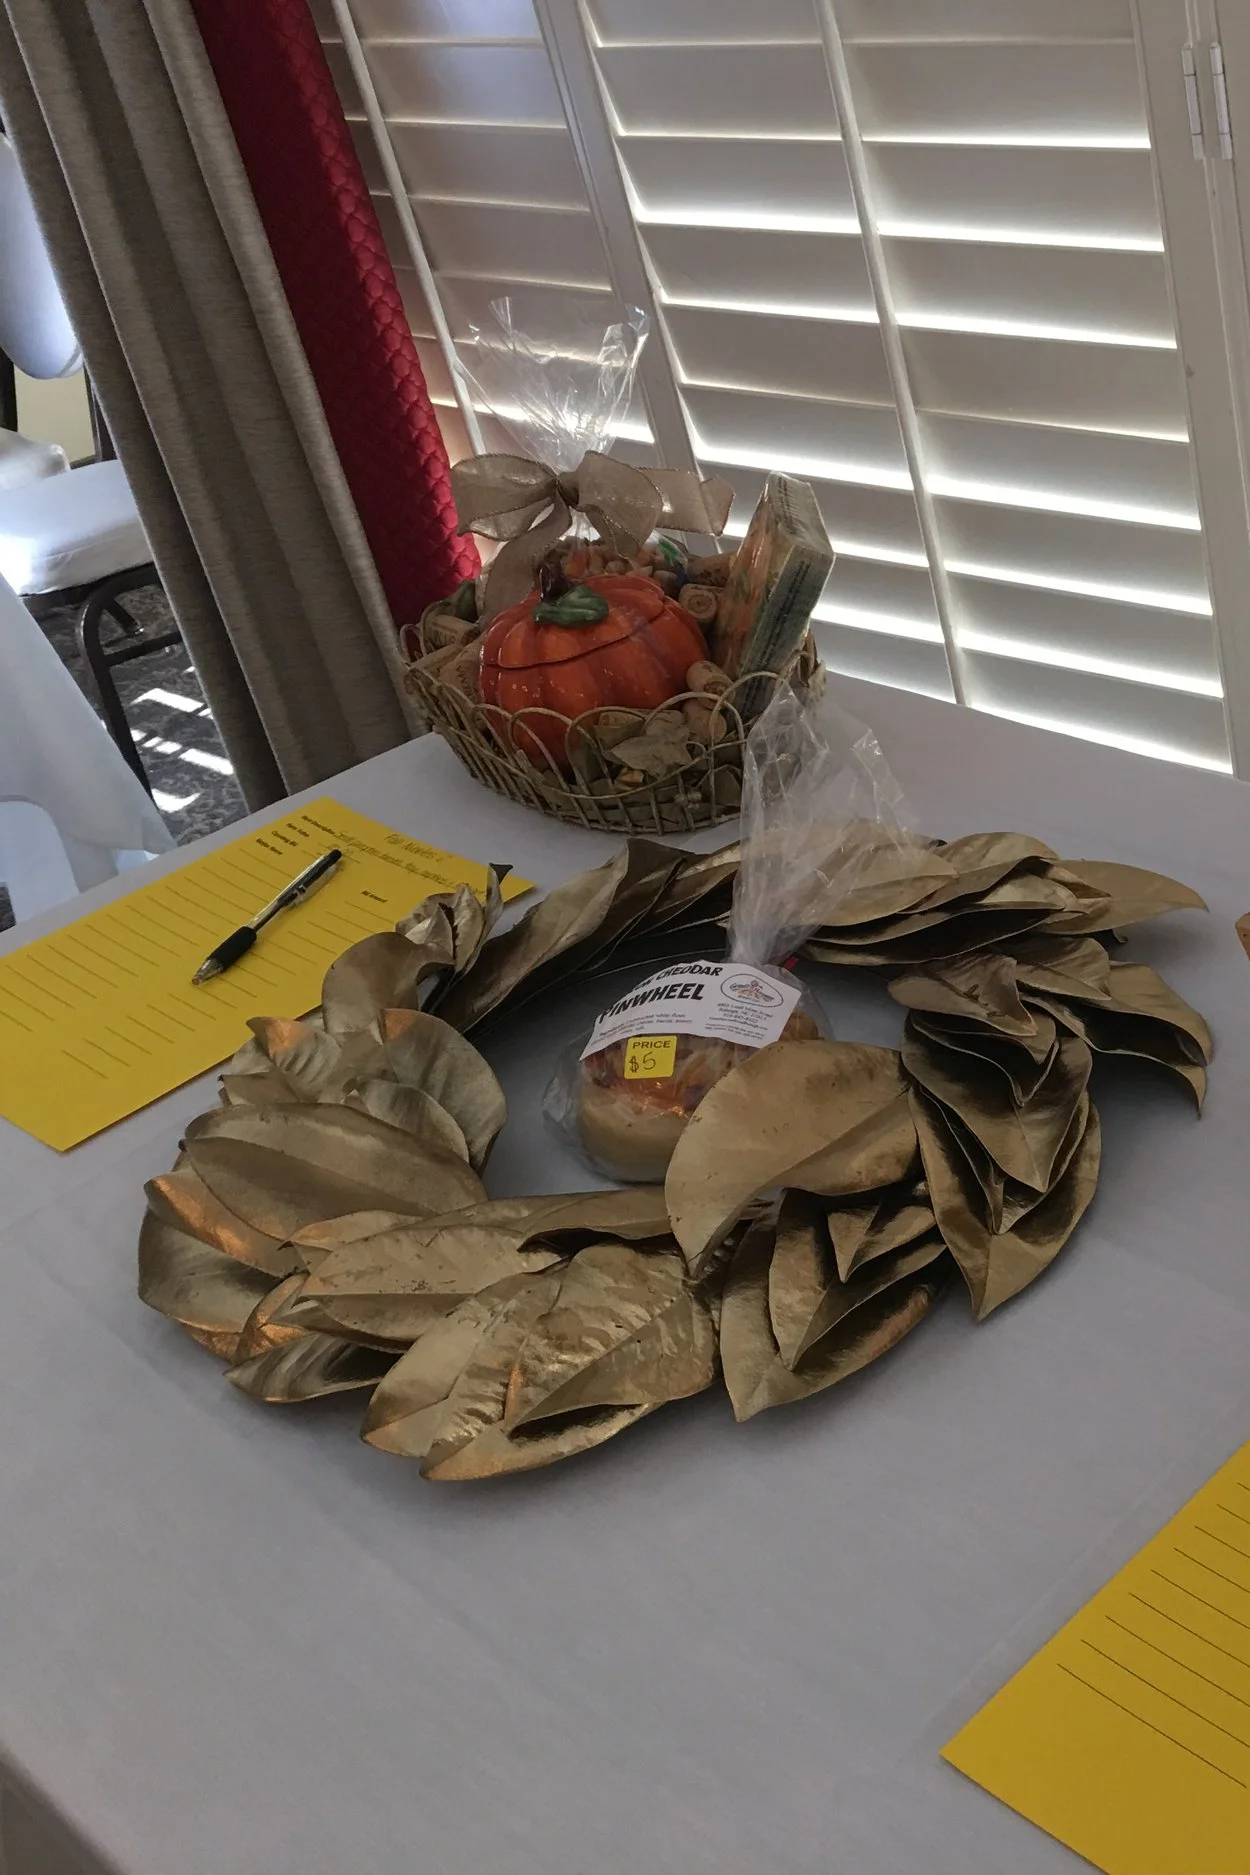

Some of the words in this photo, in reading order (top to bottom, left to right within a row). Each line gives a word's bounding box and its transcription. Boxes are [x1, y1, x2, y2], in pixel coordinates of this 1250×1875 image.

[655, 963, 724, 983] CHEDDAR
[632, 1040, 672, 1050] PRICE
[628, 1050, 657, 1073] $5
